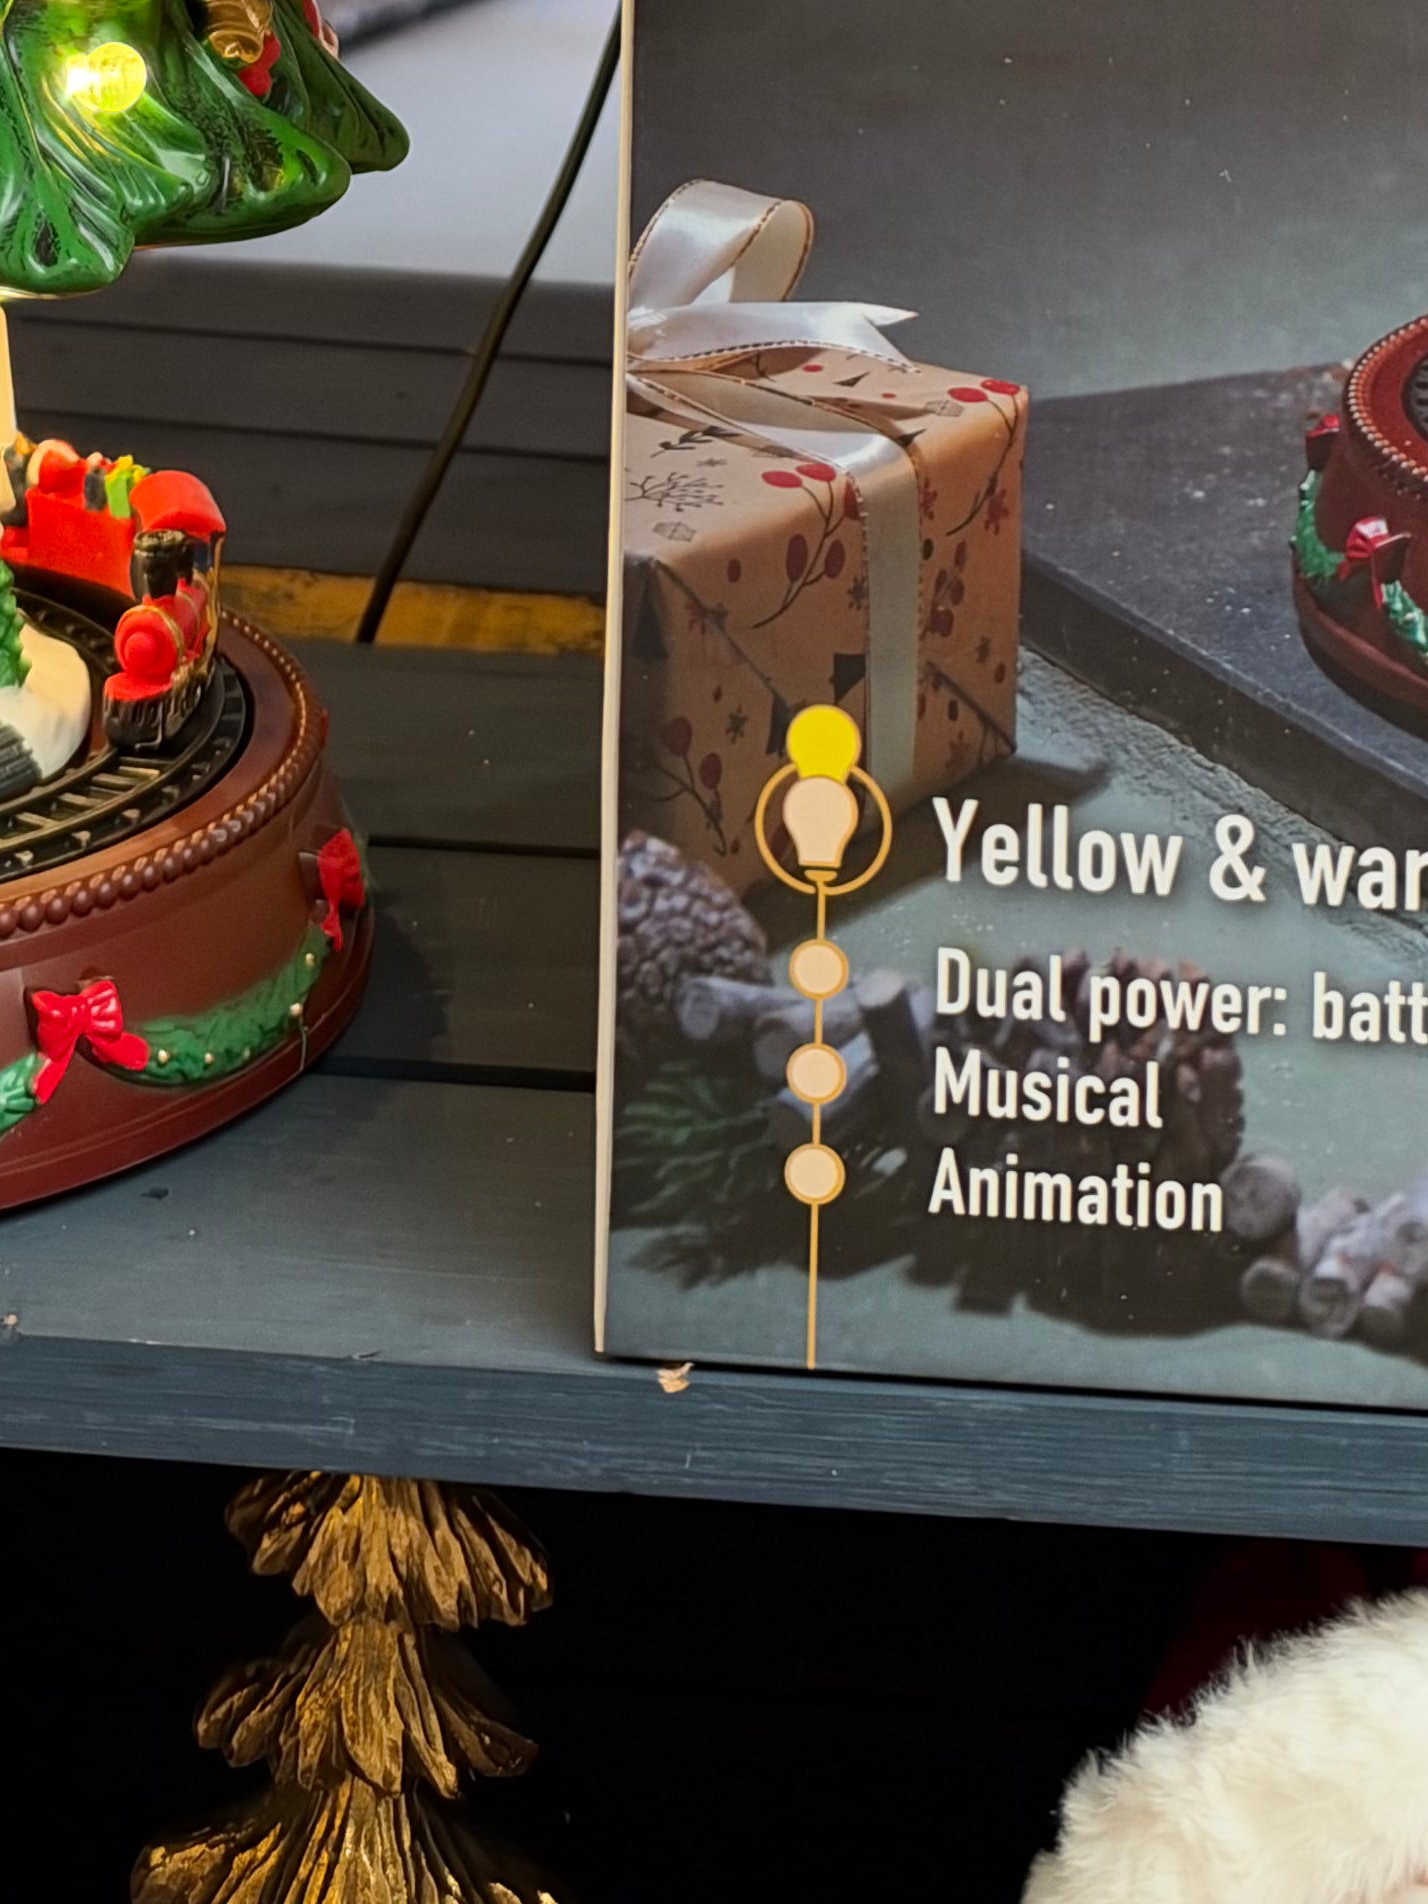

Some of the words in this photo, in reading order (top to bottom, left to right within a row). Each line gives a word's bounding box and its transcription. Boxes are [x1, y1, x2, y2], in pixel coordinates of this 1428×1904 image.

[933, 797, 1183, 896] Yellow
[1209, 814, 1267, 902] &
[936, 947, 1066, 1022] Dual
[1090, 975, 1288, 1042] power:
[934, 1047, 1164, 1128] Musical
[928, 1147, 1224, 1233] Animation
